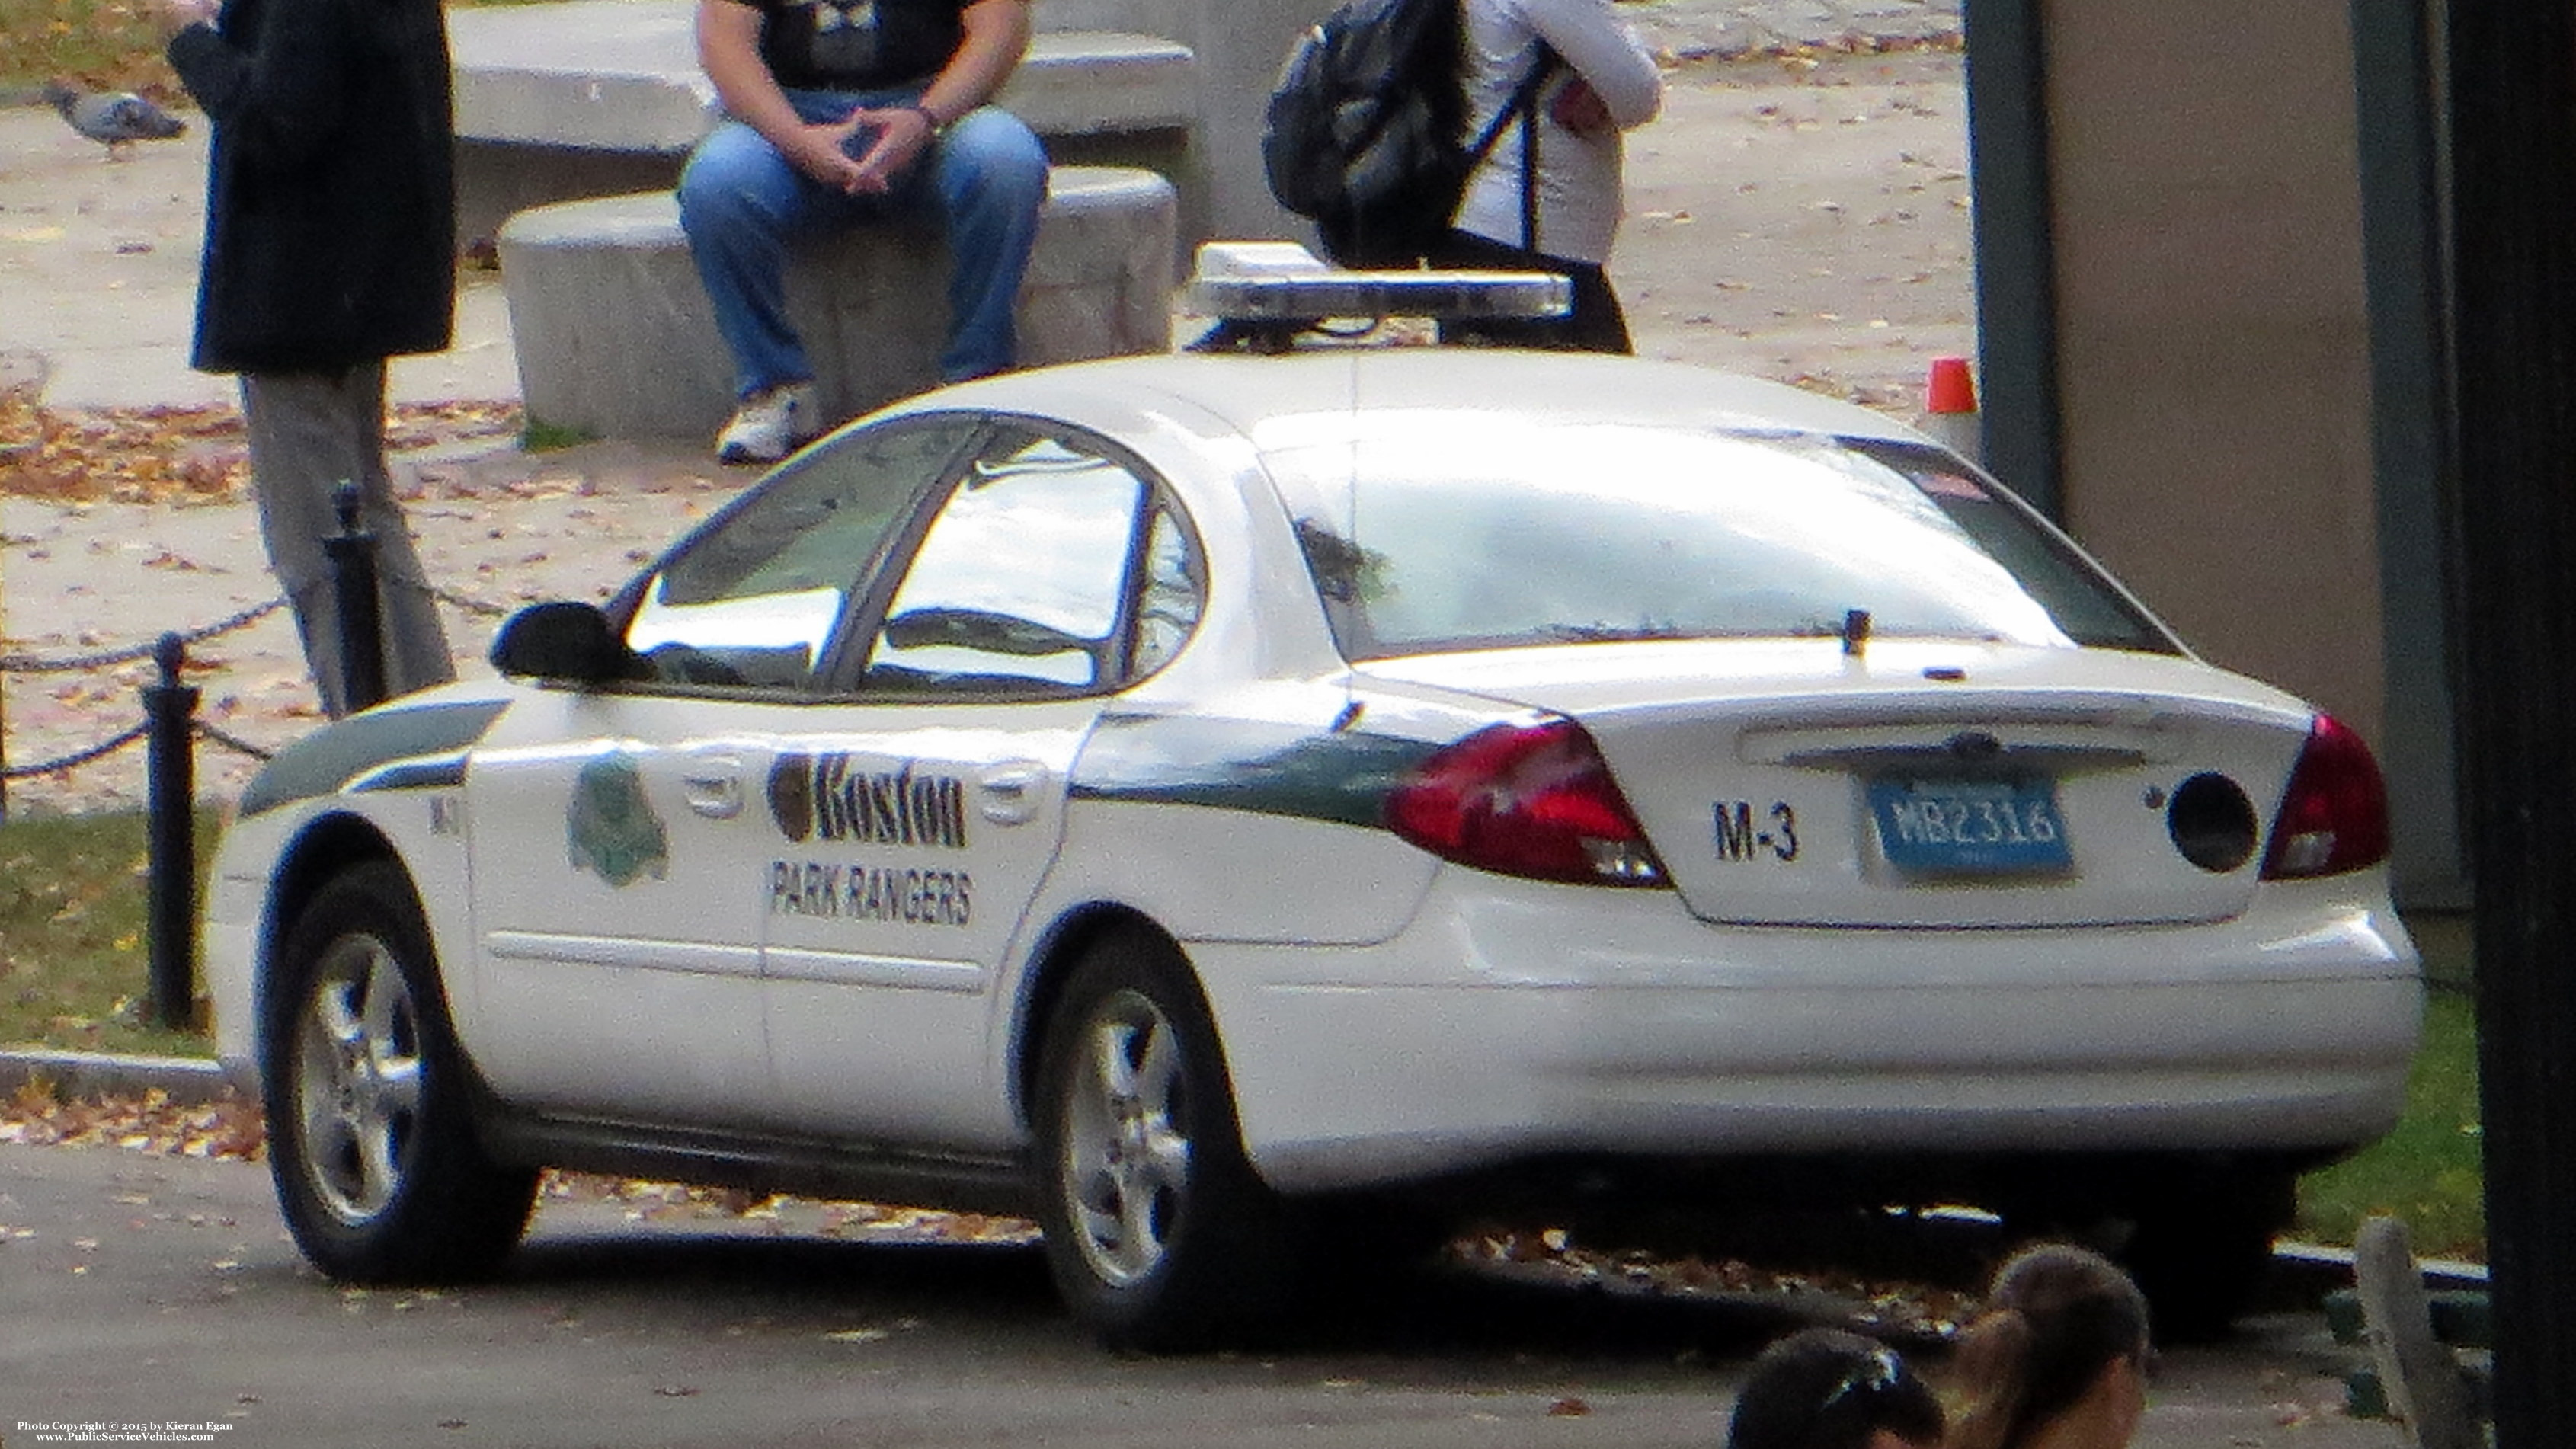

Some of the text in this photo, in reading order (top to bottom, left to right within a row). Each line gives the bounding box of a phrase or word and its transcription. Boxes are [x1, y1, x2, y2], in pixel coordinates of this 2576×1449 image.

[814, 751, 965, 847] Boston
[1891, 799, 2055, 843] MB2316
[1714, 801, 1798, 862] M-3
[771, 861, 973, 925] PARK RANGERS
